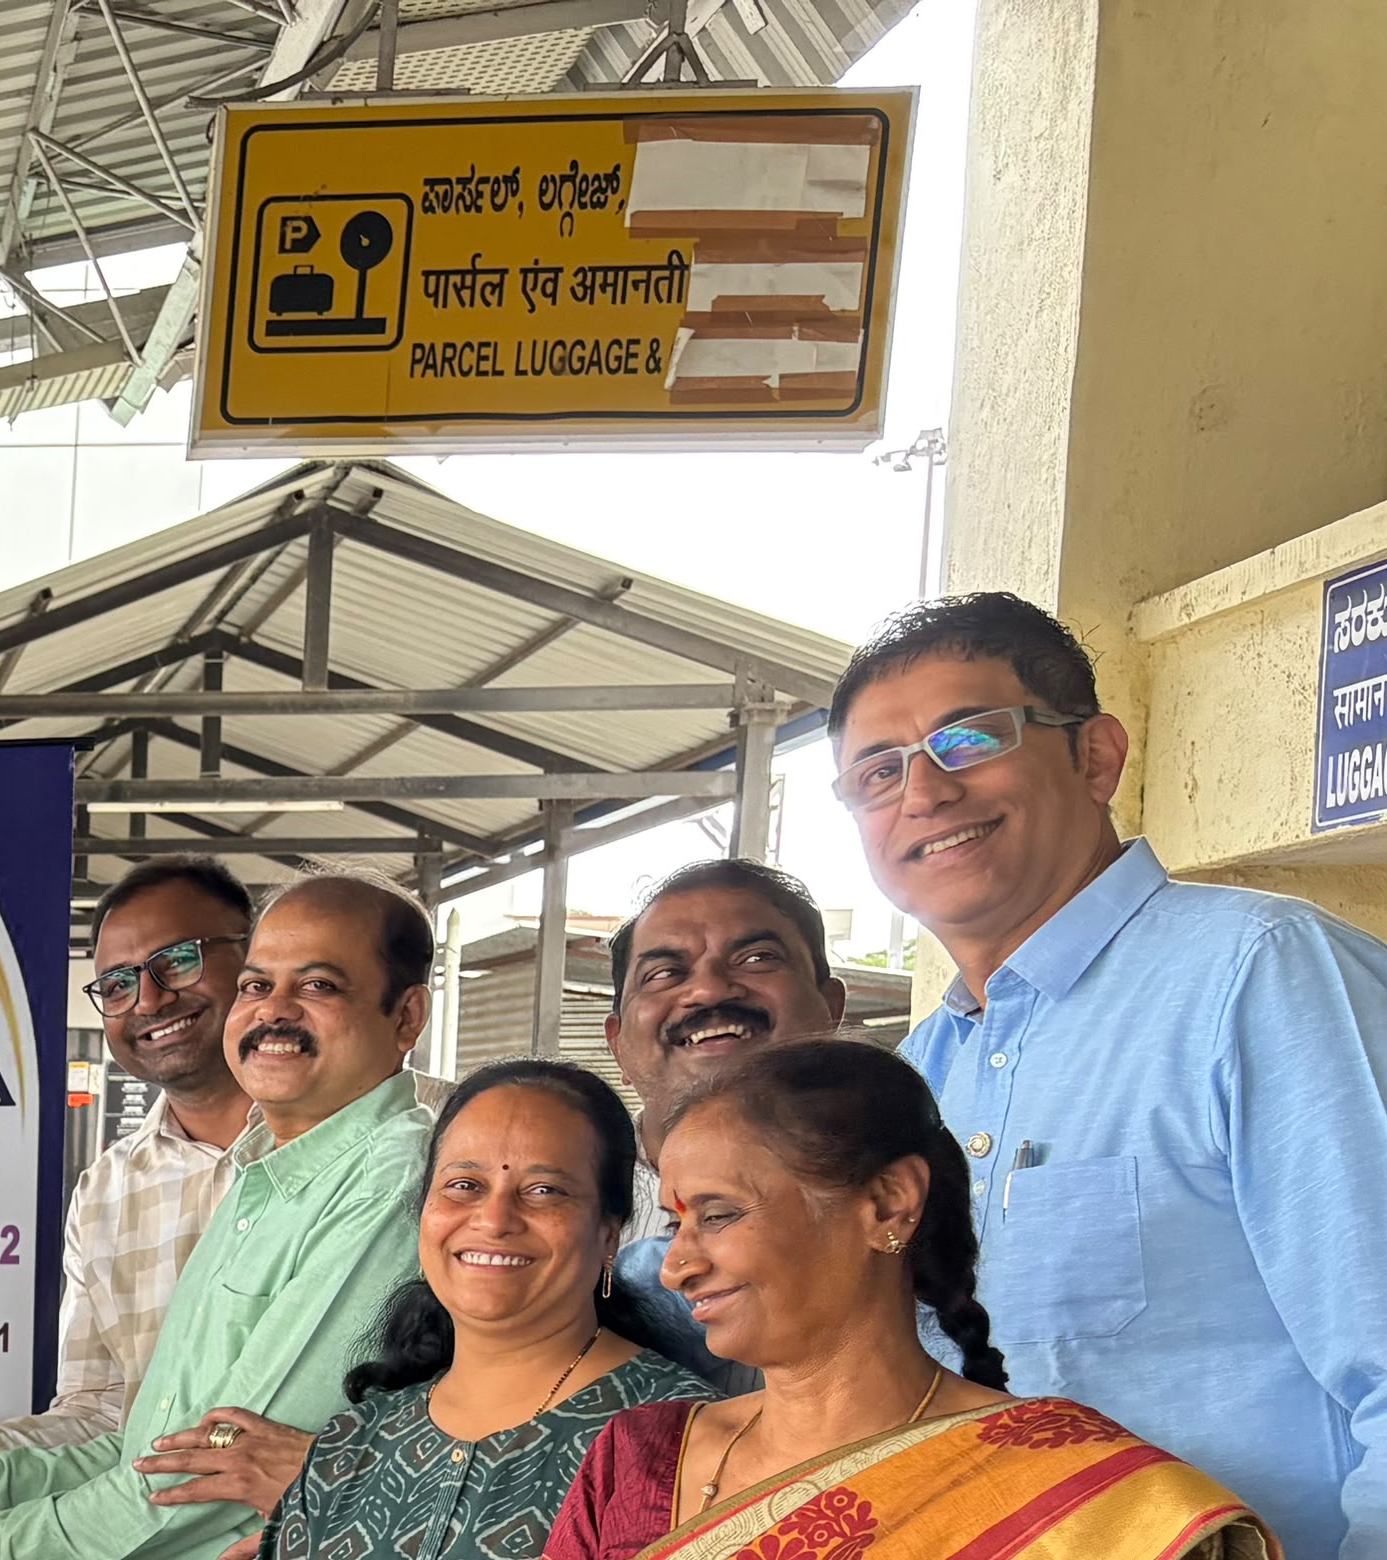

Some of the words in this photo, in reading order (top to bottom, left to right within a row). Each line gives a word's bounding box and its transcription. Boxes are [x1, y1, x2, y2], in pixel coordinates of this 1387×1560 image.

[421, 163, 524, 219] ಪಾರ್ಸಲ್,
[421, 253, 509, 310] पार्सल
[569, 249, 690, 306] अमानती
[409, 341, 505, 379] PARCEL
[514, 338, 641, 377] LUGGAGE
[644, 337, 662, 375] &
